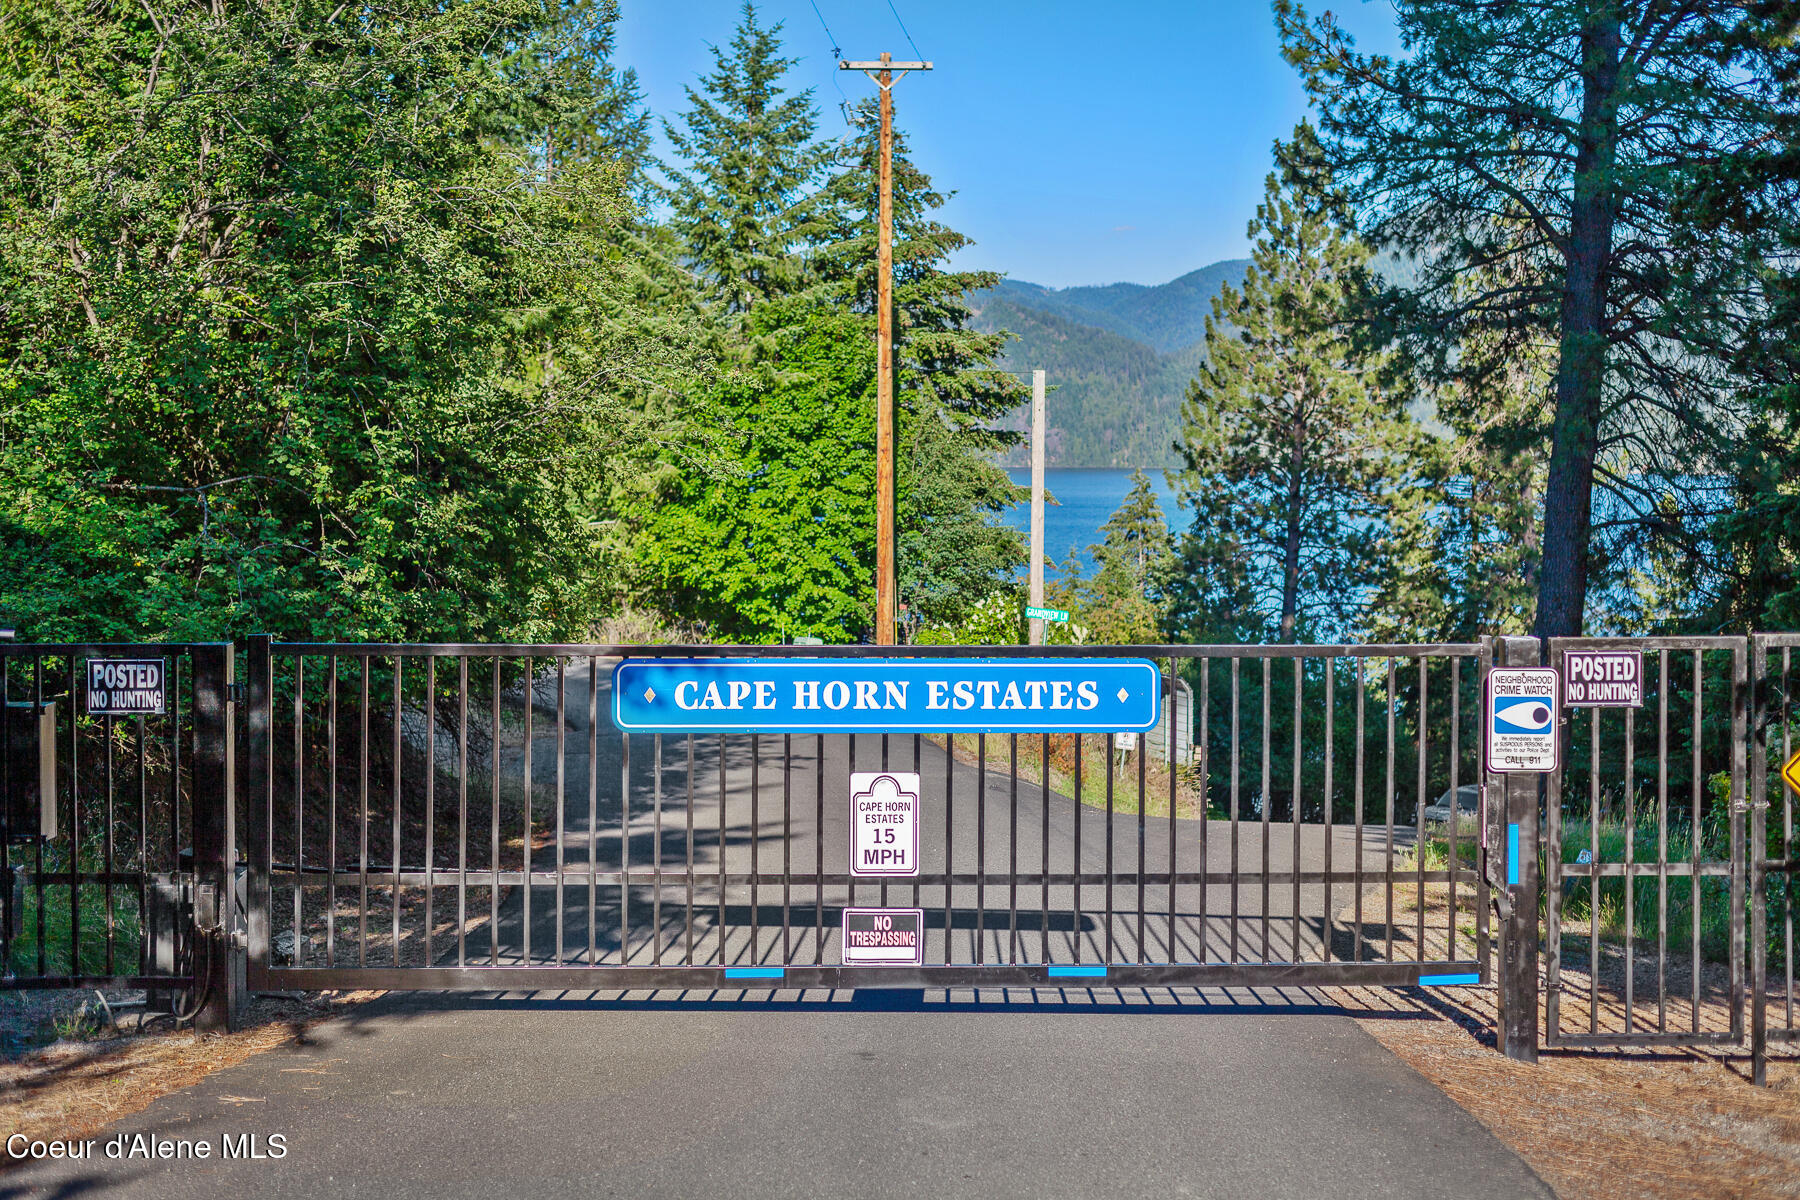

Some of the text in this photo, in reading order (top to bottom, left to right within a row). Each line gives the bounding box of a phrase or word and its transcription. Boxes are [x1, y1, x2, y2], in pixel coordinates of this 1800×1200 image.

[1027, 608, 1069, 621] GRANDVIEW LN
[93, 664, 159, 689] POSTED
[1570, 656, 1636, 681] POSTED
[1495, 675, 1553, 684] NEIGHBORHOOD
[674, 680, 1100, 710] CAPE HORN ESTATES
[1494, 685, 1553, 695] CRIME WATCH
[1568, 683, 1639, 701] NO HUNTING
[91, 690, 162, 708] NO HUNTING
[1505, 756, 1541, 764] CALL 911
[860, 802, 911, 812] CAPE HORN
[865, 814, 905, 824] ESTATES
[873, 828, 896, 844] 15
[863, 849, 905, 865] MPH
[874, 915, 893, 931] NO
[850, 931, 916, 946] TRESPASSING
